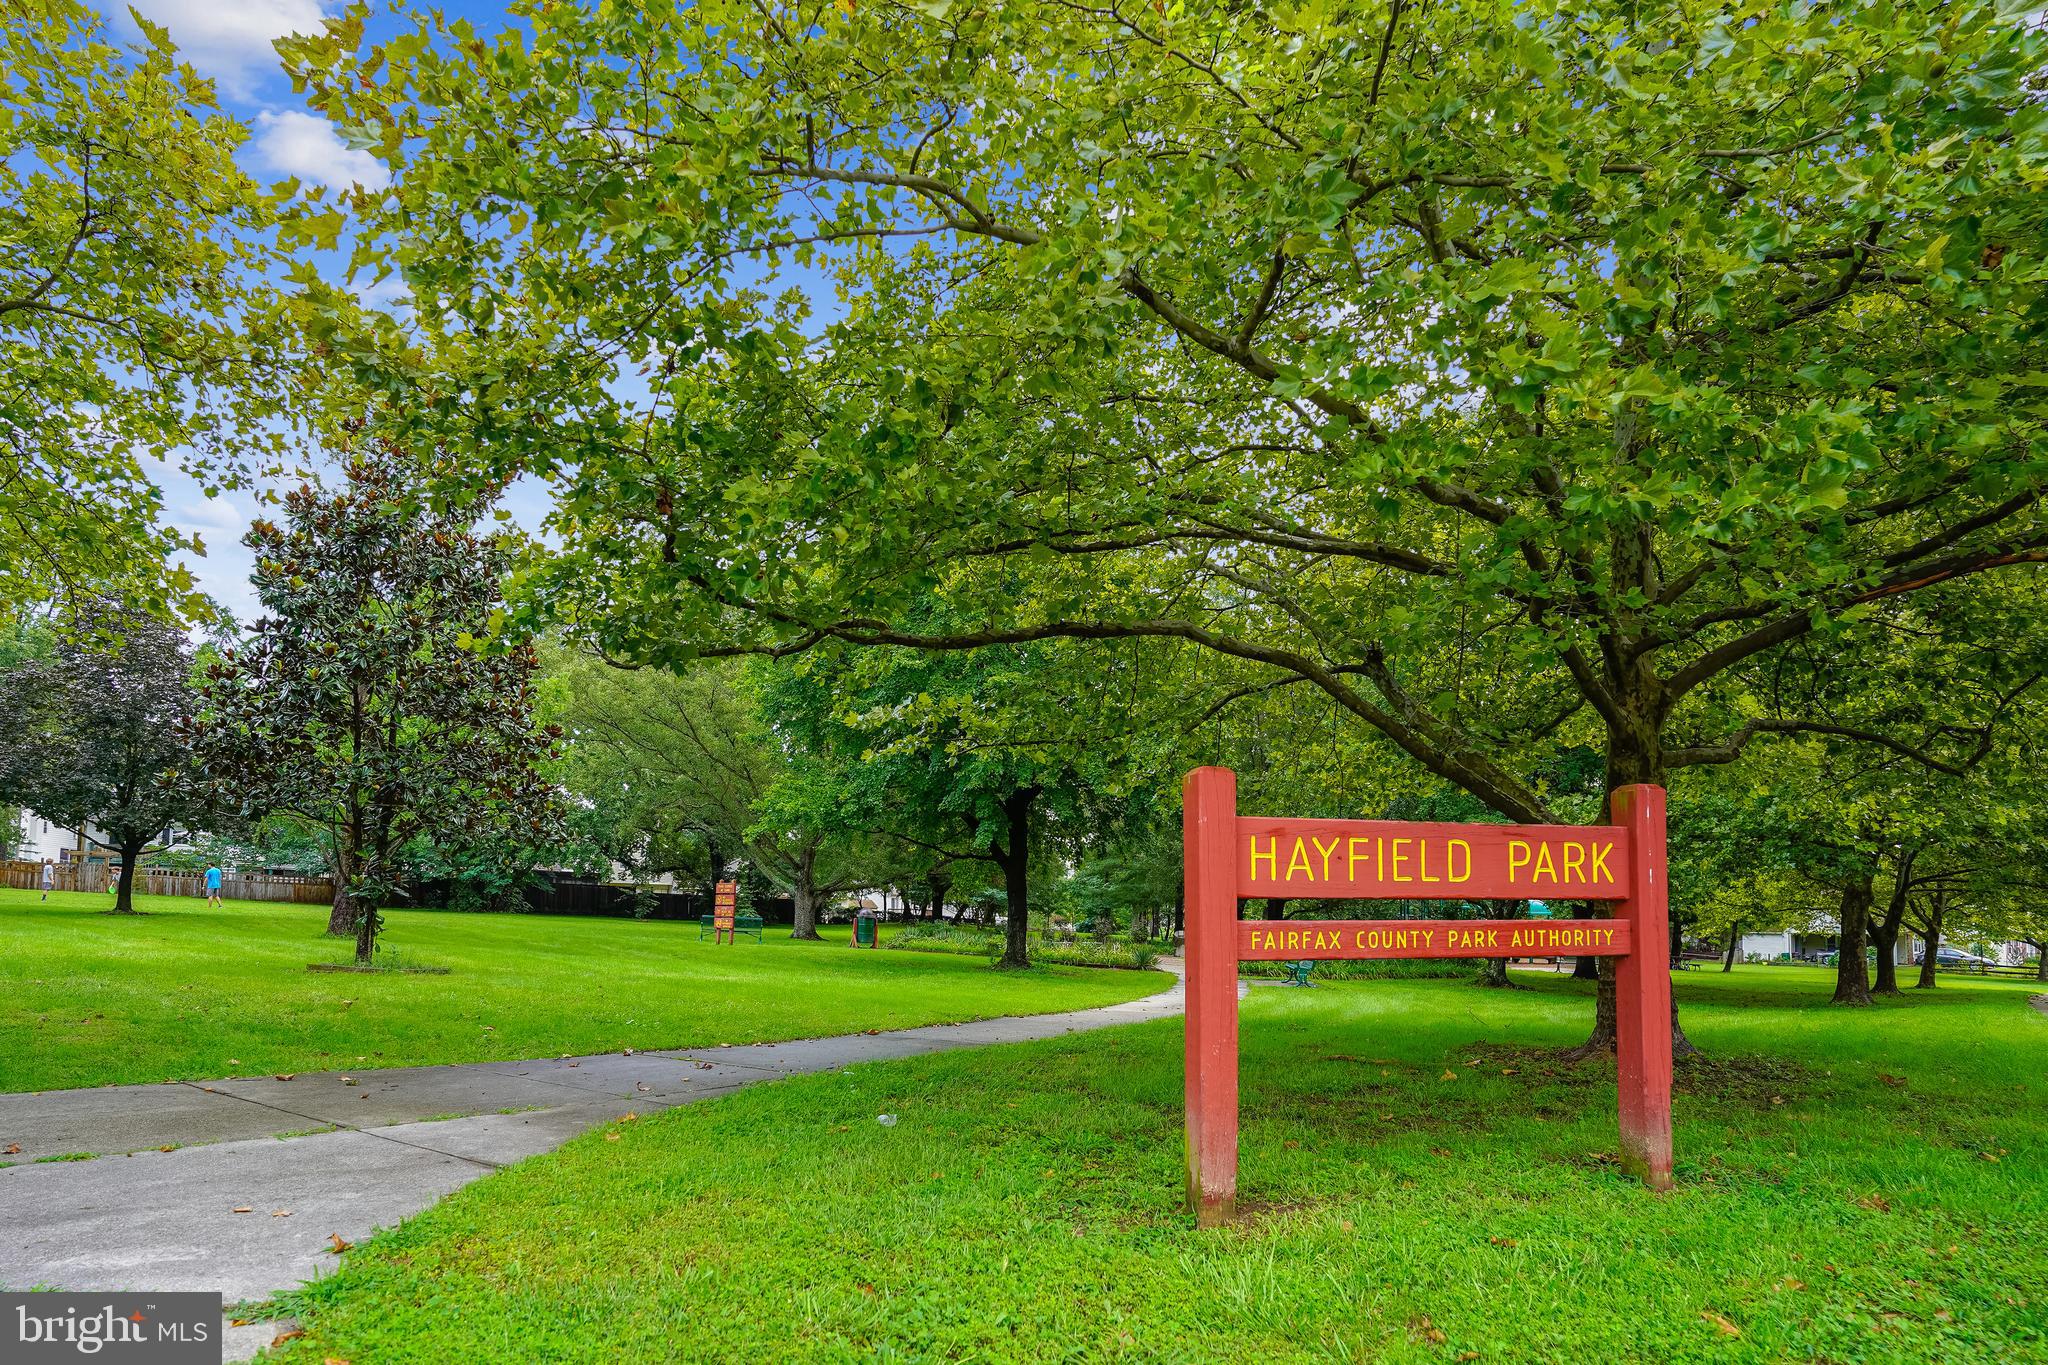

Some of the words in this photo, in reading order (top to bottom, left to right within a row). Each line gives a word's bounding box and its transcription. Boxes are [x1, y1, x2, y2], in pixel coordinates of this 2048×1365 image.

[1250, 835, 1472, 883] HAYFIELD
[1508, 840, 1615, 884] PARK
[1251, 930, 1342, 950] FAIRFAX
[1356, 930, 1434, 949] COUNTY
[1448, 929, 1498, 948] PARK
[1511, 929, 1614, 948] AUTHORITY
